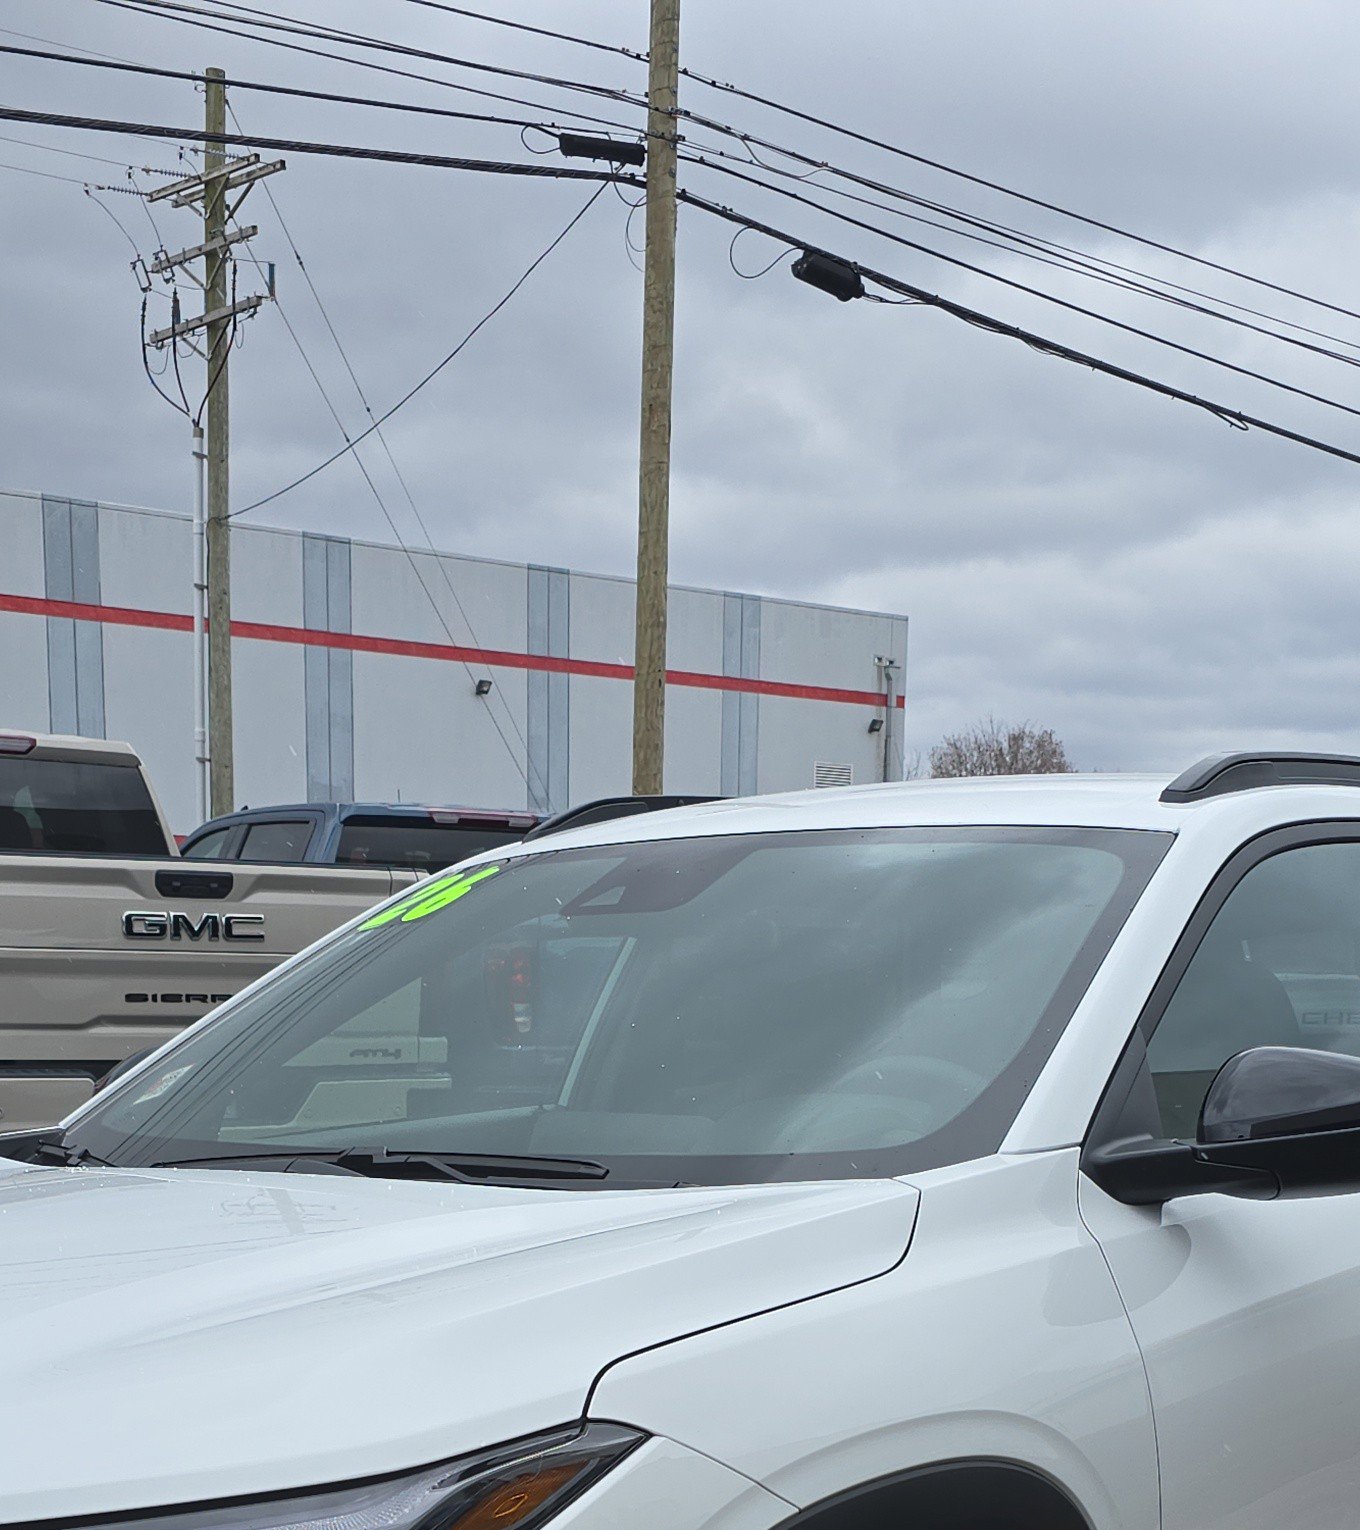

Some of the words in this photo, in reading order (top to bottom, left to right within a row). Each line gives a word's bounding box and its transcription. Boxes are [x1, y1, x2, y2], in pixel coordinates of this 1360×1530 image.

[356, 865, 500, 932] 26
[122, 911, 265, 942] GMC
[124, 993, 235, 1004] SIERR
